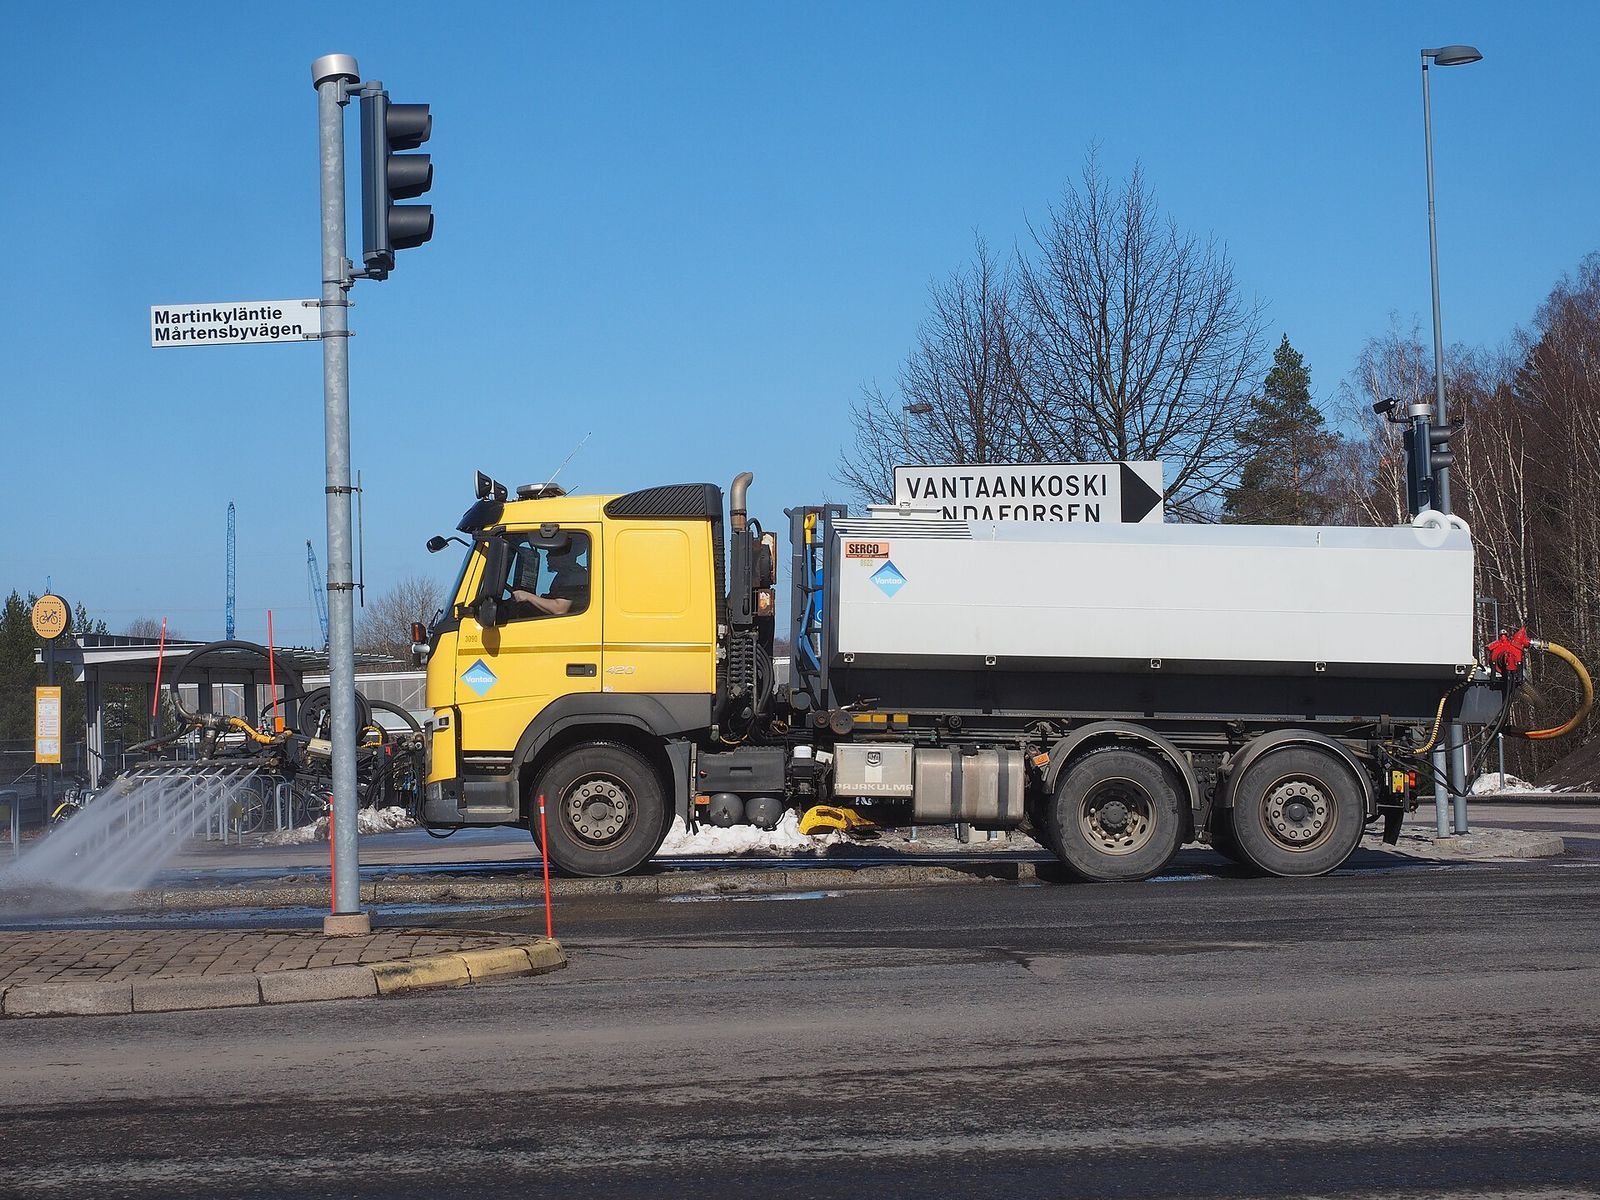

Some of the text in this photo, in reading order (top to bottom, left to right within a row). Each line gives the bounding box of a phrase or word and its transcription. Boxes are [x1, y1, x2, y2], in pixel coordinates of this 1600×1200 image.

[154, 306, 283, 325] Martinkyläntie
[155, 323, 302, 341] Mårtensbyvägen
[906, 474, 1107, 499] VANTAANKOSKI
[942, 503, 1101, 523] NDAFORSEN
[848, 543, 880, 554] SERCO
[874, 576, 903, 585] Vantaa
[605, 665, 636, 675] 420
[465, 675, 494, 684] Vantaa
